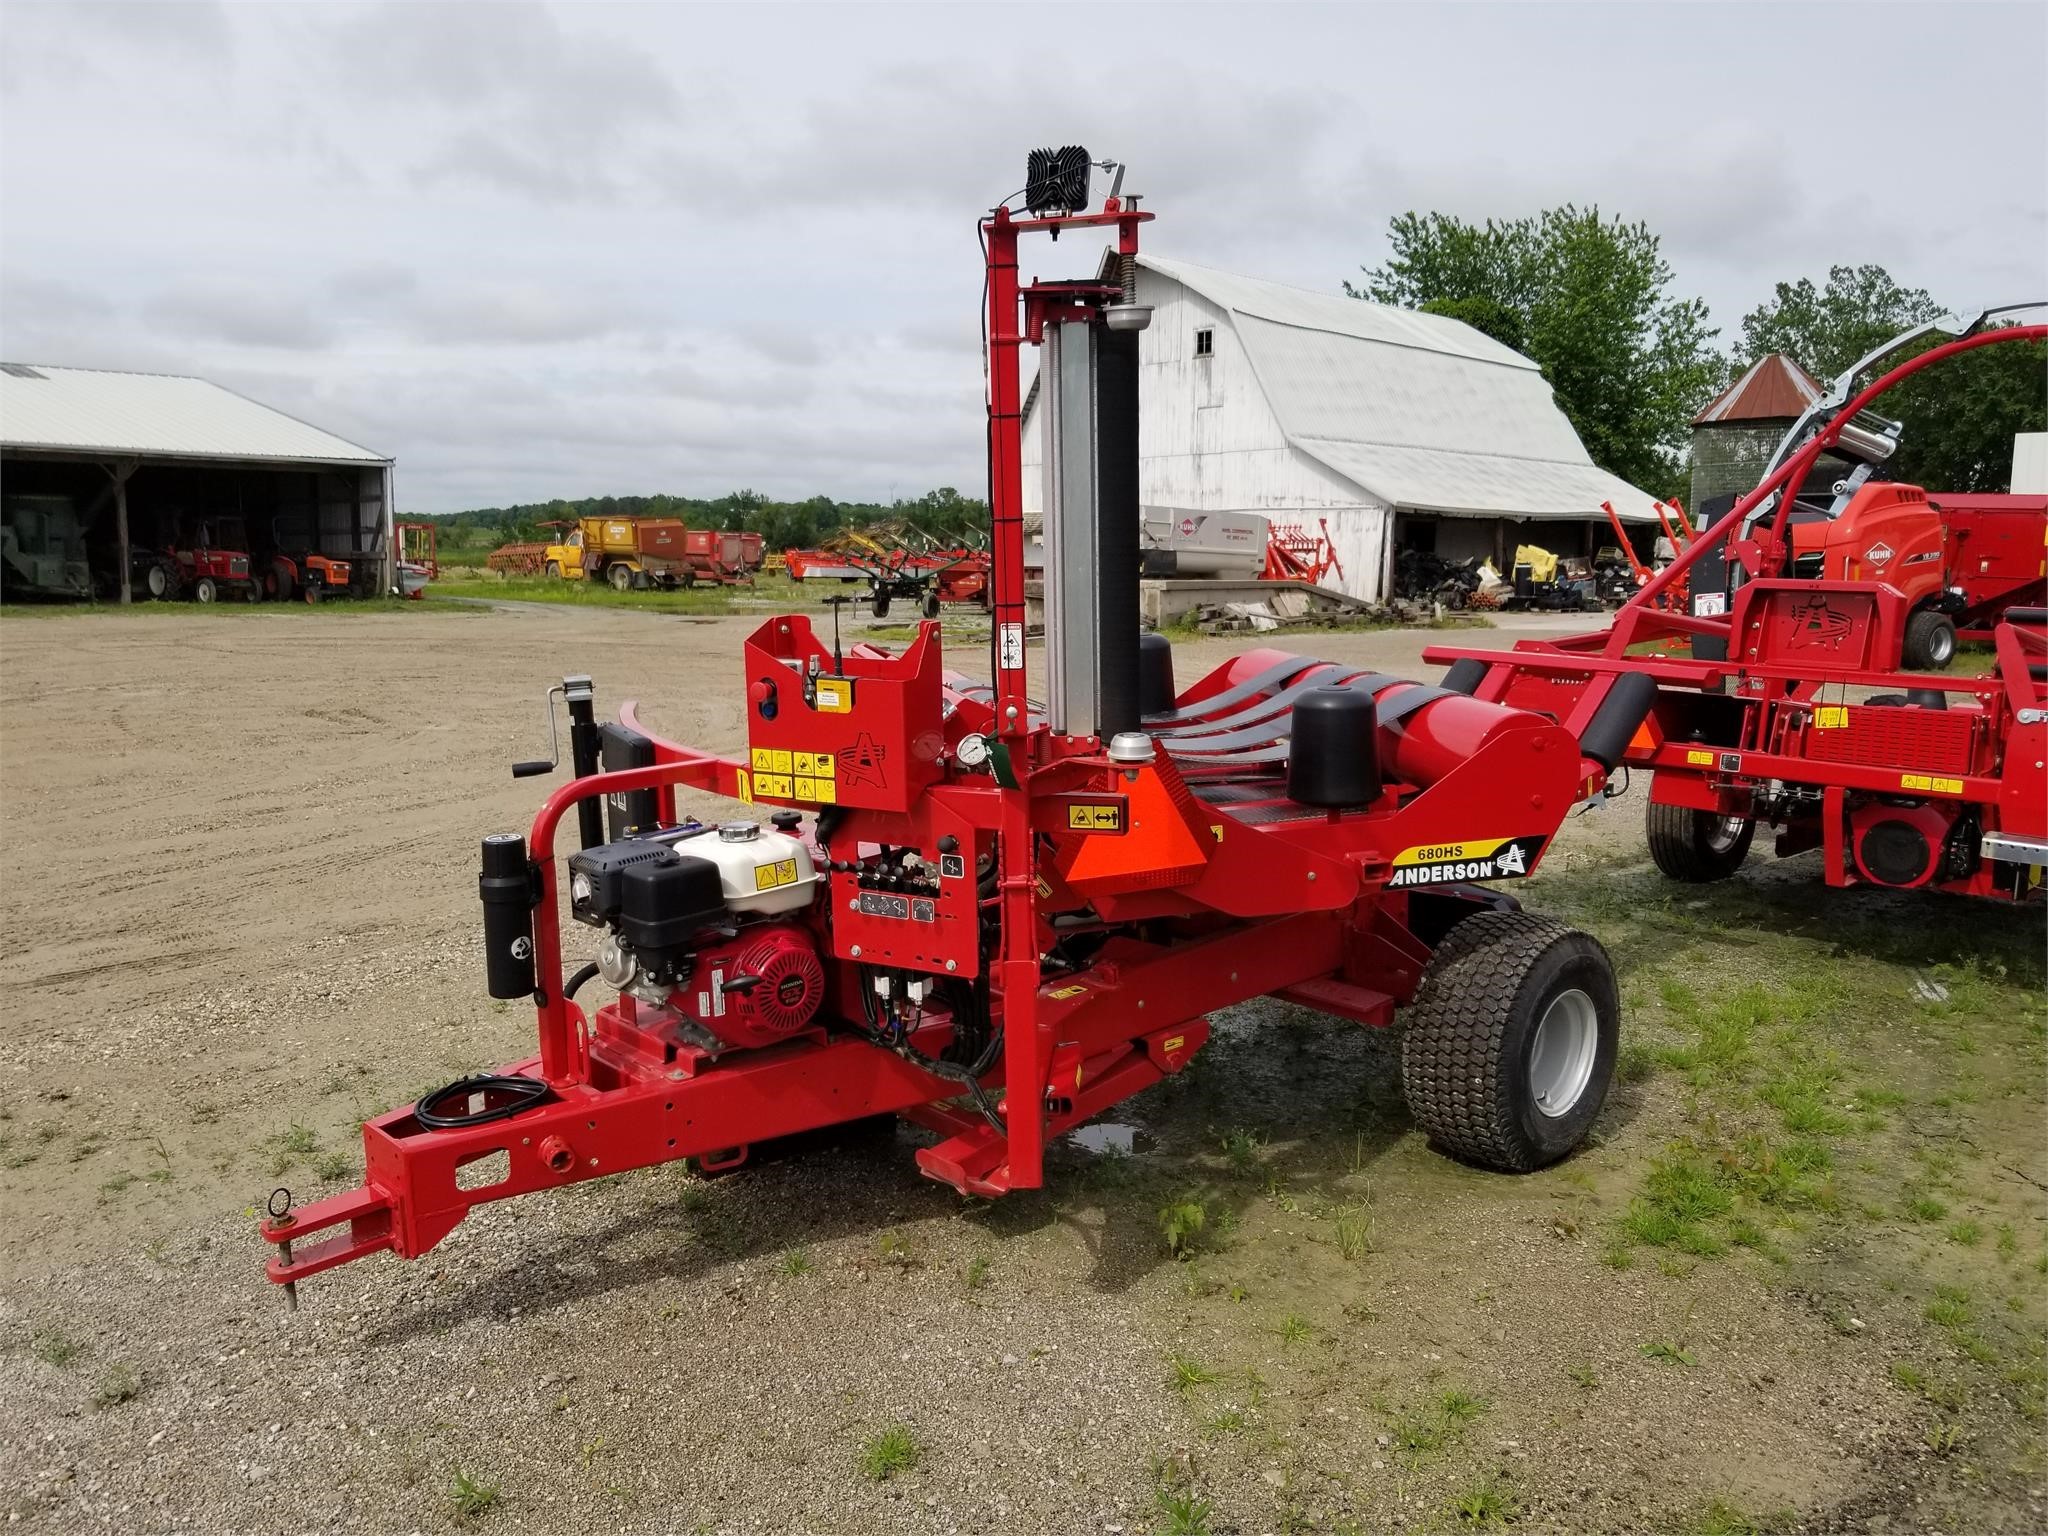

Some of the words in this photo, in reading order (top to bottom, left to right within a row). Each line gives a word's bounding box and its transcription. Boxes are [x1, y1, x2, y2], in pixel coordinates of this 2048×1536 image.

[1869, 550, 1891, 561] KUHN
[1417, 845, 1463, 860] 680HS
[1389, 861, 1492, 886] ANDERSON
[780, 979, 804, 990] HONDA
